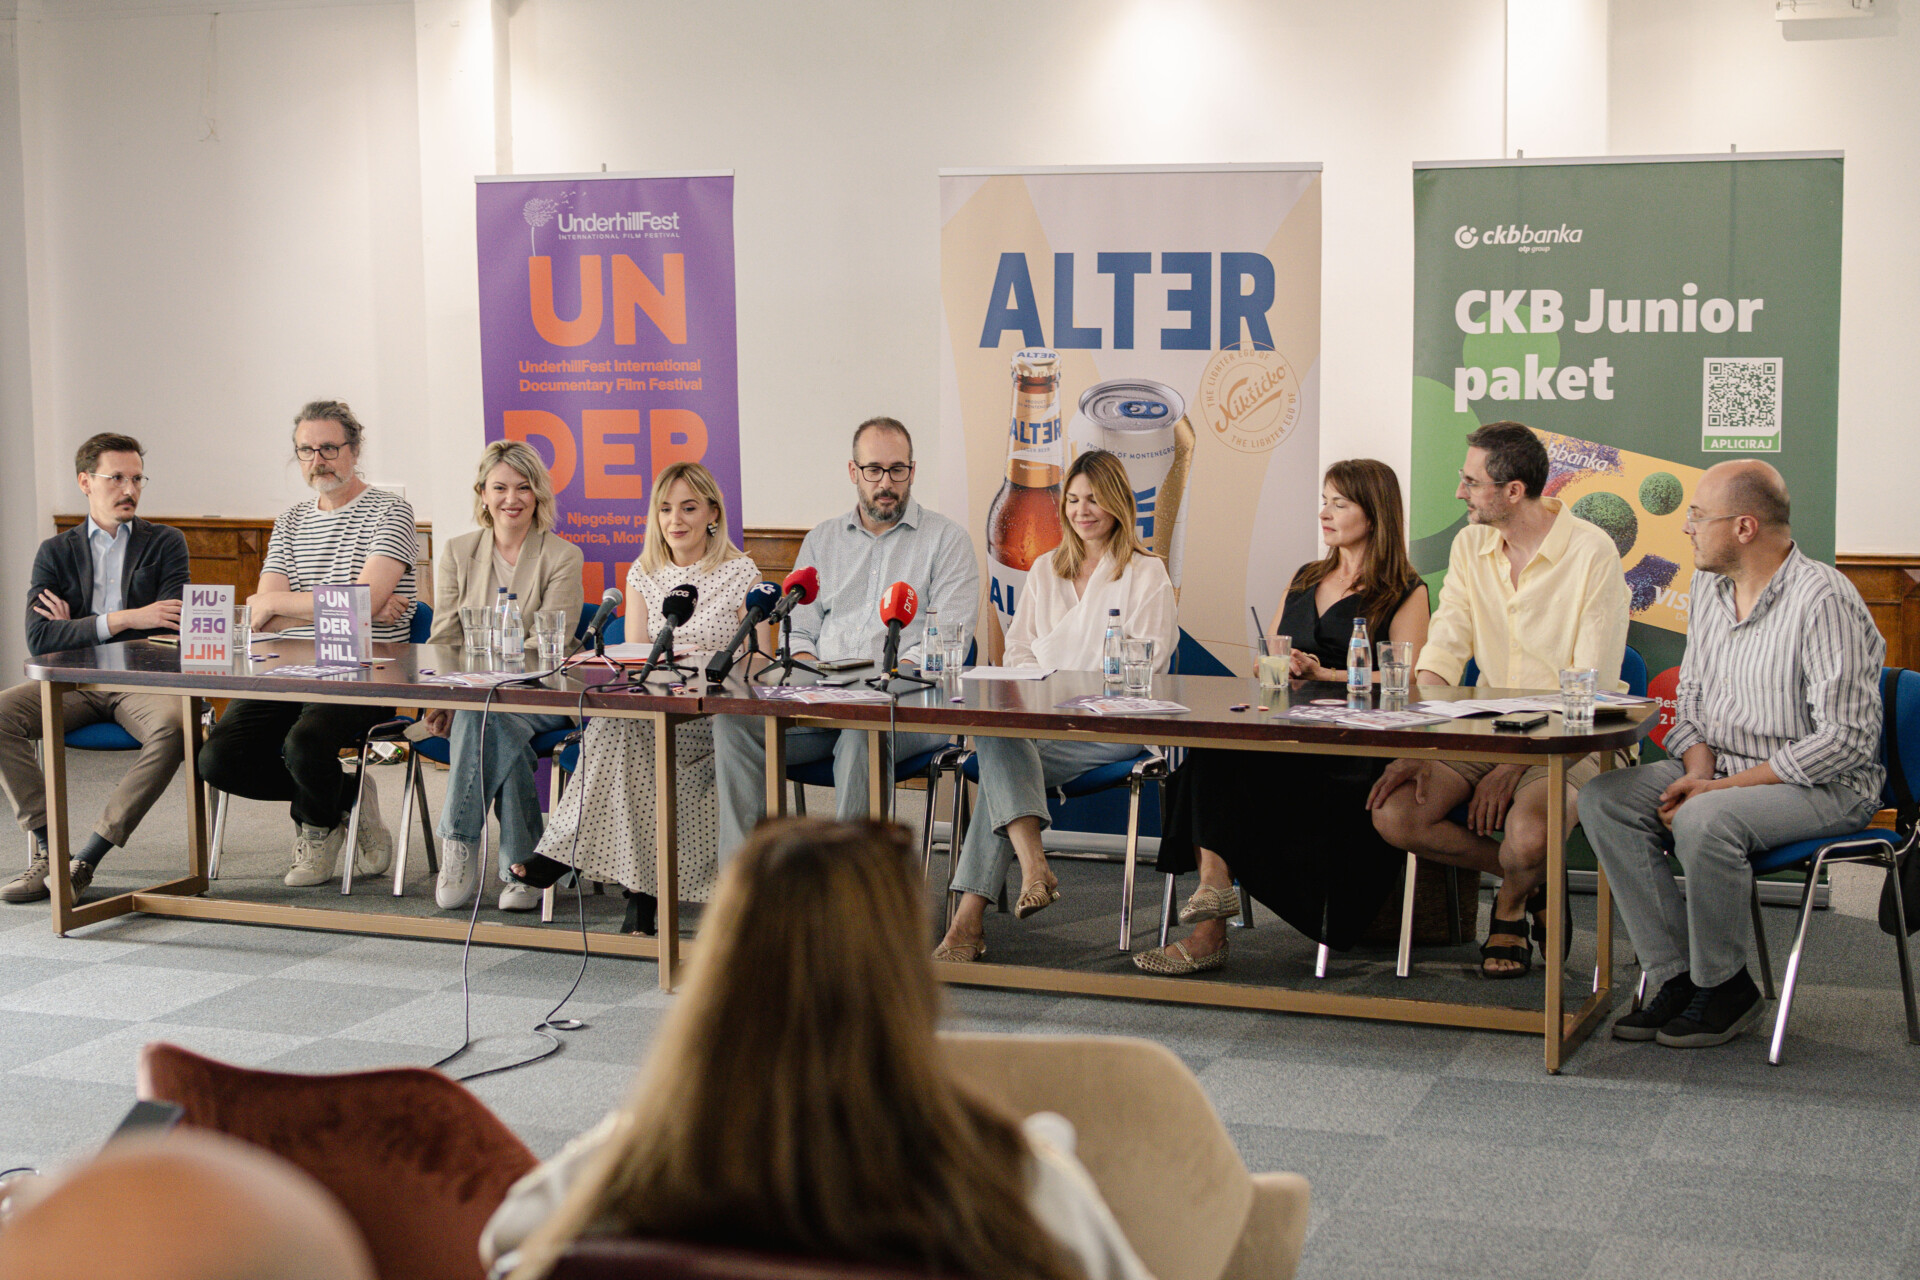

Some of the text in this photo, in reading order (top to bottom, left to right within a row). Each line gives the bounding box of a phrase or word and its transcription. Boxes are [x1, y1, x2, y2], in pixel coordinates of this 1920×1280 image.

[558, 211, 680, 233] UnderhillFest
[1482, 223, 1583, 245] ckbbanka
[1531, 246, 1550, 254] group
[528, 253, 688, 347] UN
[1454, 282, 1764, 334] CKB Junior
[519, 359, 701, 373] UnderhillFest International
[519, 377, 702, 394] Documentary Film Festival
[1206, 349, 1271, 408] THE LIGHTER EGO OF
[1453, 354, 1615, 413] paket
[1231, 392, 1297, 448] THE LIGHTER EGO OF
[1129, 446, 1175, 460] MONTENEGRO
[1710, 438, 1772, 450] APLICIRAJ
[567, 512, 648, 528] Njegošev pa
[325, 590, 350, 608] UN
[903, 588, 915, 614] prva
[1652, 585, 1690, 610] VIS
[319, 617, 352, 636] DER
[320, 643, 357, 662] HILL
[1660, 713, 1668, 725] 2
